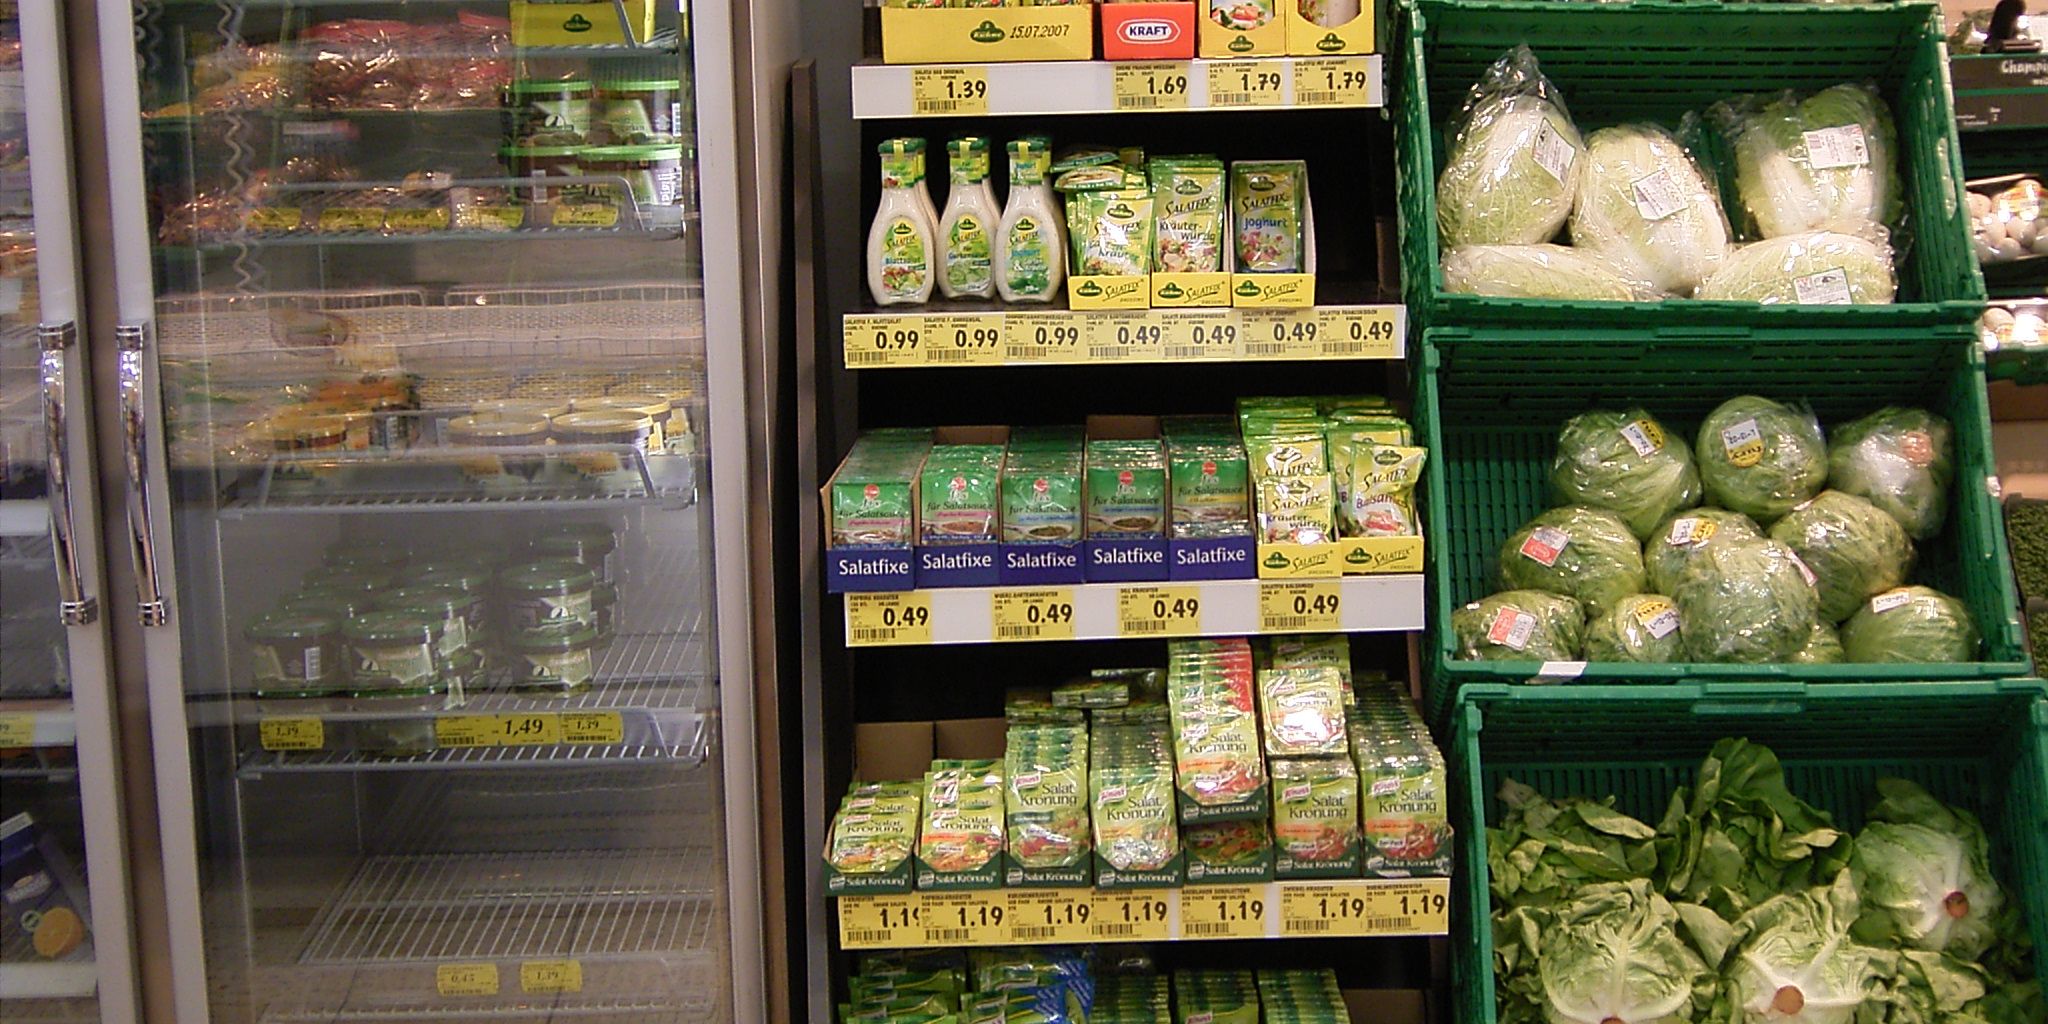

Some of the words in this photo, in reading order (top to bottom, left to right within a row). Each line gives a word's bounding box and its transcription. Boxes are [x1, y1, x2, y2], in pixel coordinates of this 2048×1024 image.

[1010, 24, 1070, 39] 15.07.2007
[1129, 26, 1168, 36] KRAFT
[946, 80, 986, 98] 1.39
[1147, 76, 1187, 94] 1.69
[1241, 73, 1281, 91] 1.79
[1327, 71, 1366, 90] 1.79
[876, 330, 919, 349] 0.99
[955, 329, 998, 348] 0.99
[1035, 327, 1079, 346] 0.99
[1118, 325, 1161, 344] 0.49
[1193, 325, 1236, 344] 0.49
[1274, 322, 1316, 341] 0.49
[1350, 321, 1393, 340] 0.49
[927, 502, 939, 511] für
[923, 552, 992, 569] Salatfixe
[1007, 552, 1076, 568] Salatfixe
[1094, 548, 1163, 564] Salatfixe
[1177, 548, 1246, 564] Salatfixe
[839, 558, 909, 576] Salatfixe
[1154, 598, 1198, 618] 0.49
[1294, 594, 1339, 614] 0.49
[883, 606, 928, 626] 0.49
[1027, 604, 1072, 623] 0.49
[505, 719, 543, 735] 1,49
[576, 720, 599, 730] 1,39
[1211, 732, 1244, 742] Salat
[1042, 783, 1073, 794] Salat
[1401, 789, 1434, 801] Salat
[1128, 797, 1162, 808] Salat
[1312, 795, 1344, 807] Salat
[1122, 901, 1167, 922] 1.19
[1218, 900, 1263, 920] 1.19
[1319, 898, 1364, 918] 1.19
[1401, 894, 1445, 915] 1.19
[958, 906, 1003, 926] 1.19
[1044, 904, 1089, 924] 1.19
